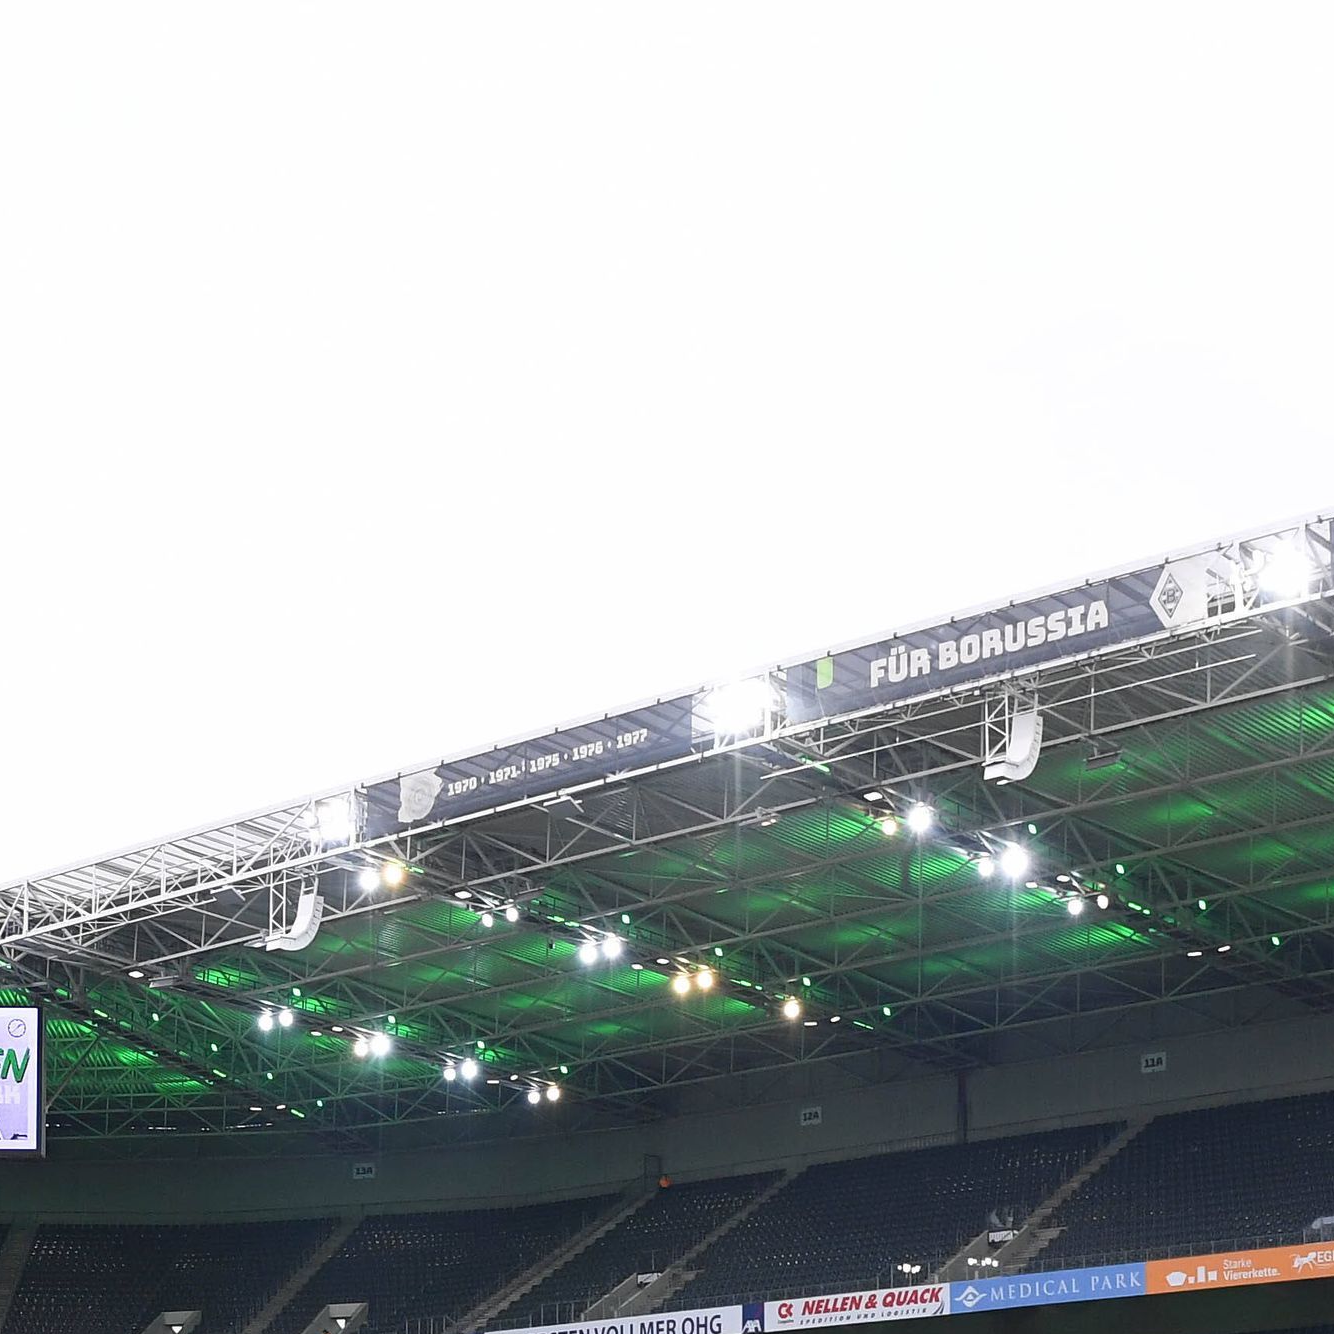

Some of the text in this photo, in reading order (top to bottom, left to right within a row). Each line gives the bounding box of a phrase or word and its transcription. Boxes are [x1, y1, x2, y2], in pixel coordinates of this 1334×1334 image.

[870, 600, 1109, 688] FÜR BORUSSIA
[447, 728, 648, 796] 1970 1971 1975 1976 1977
[1223, 1258, 1252, 1269] Starke
[1223, 1267, 1281, 1281] Viererkette.
[991, 1271, 1142, 1301] MEDICAL PARK
[801, 1287, 944, 1316] NELLEN & QUACK
[799, 1315, 852, 1326] SPEDITION
[856, 1312, 877, 1321] UND
[881, 1307, 927, 1318] LOGISTIK
